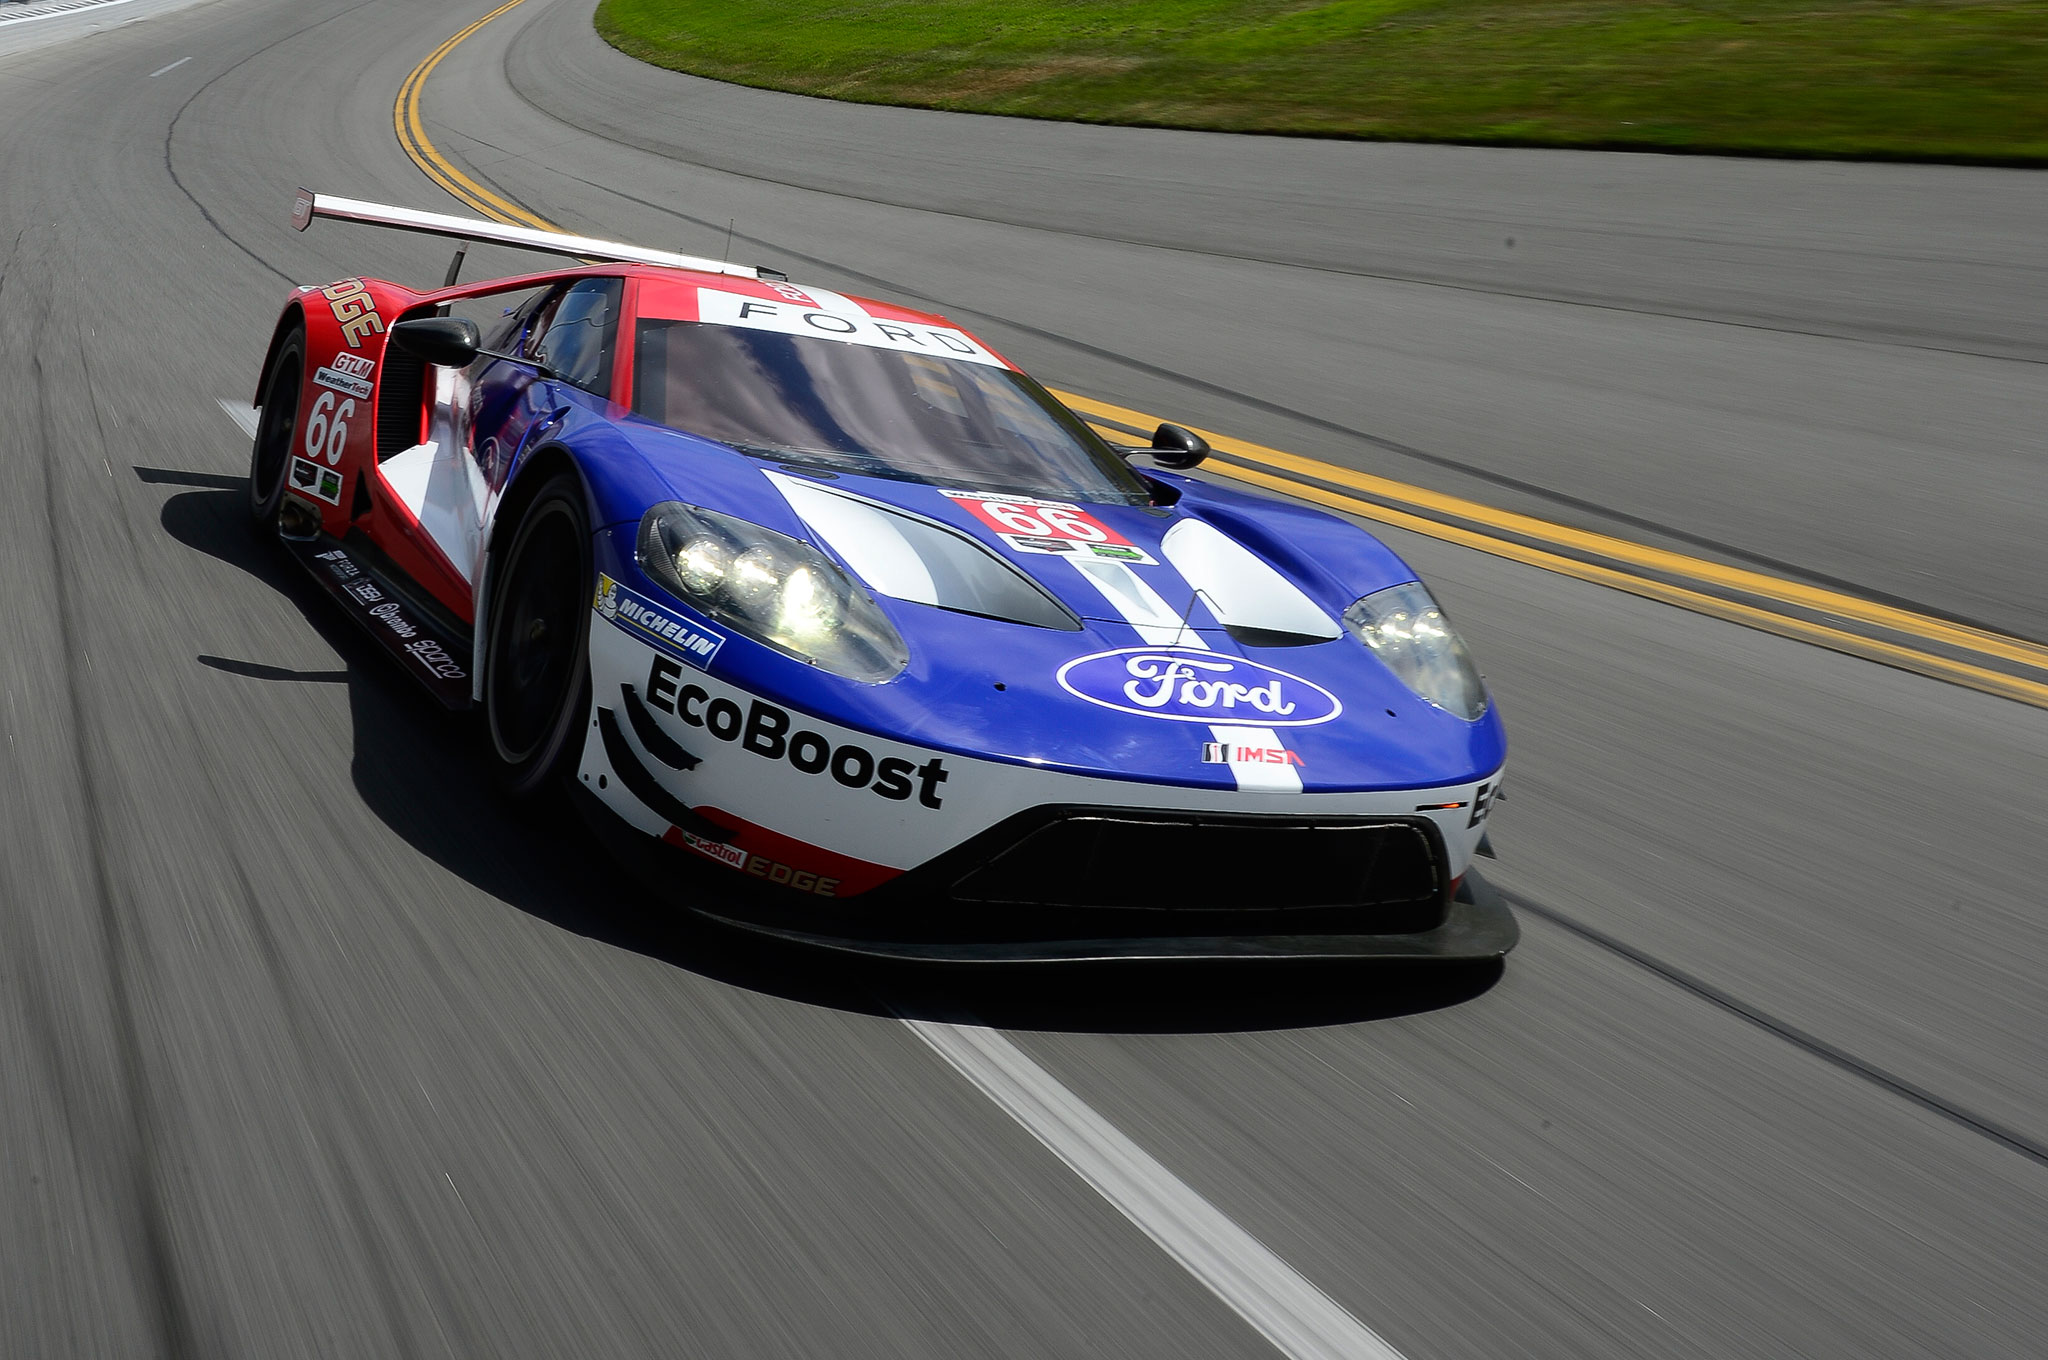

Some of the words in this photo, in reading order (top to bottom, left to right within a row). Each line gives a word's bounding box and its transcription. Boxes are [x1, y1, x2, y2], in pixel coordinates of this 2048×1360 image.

[322, 278, 384, 348] DGE
[739, 302, 977, 354] FORD
[318, 371, 370, 395] WeatherTech
[335, 355, 372, 378] GTLM
[305, 391, 355, 466] 66
[981, 501, 1108, 542] 66
[618, 598, 717, 656] MICHELIN
[406, 639, 467, 679] sparco
[1123, 655, 1297, 716] Ford
[646, 654, 949, 811] EcoBoost
[1237, 747, 1306, 767] IMSA
[747, 855, 840, 897] EDGE
